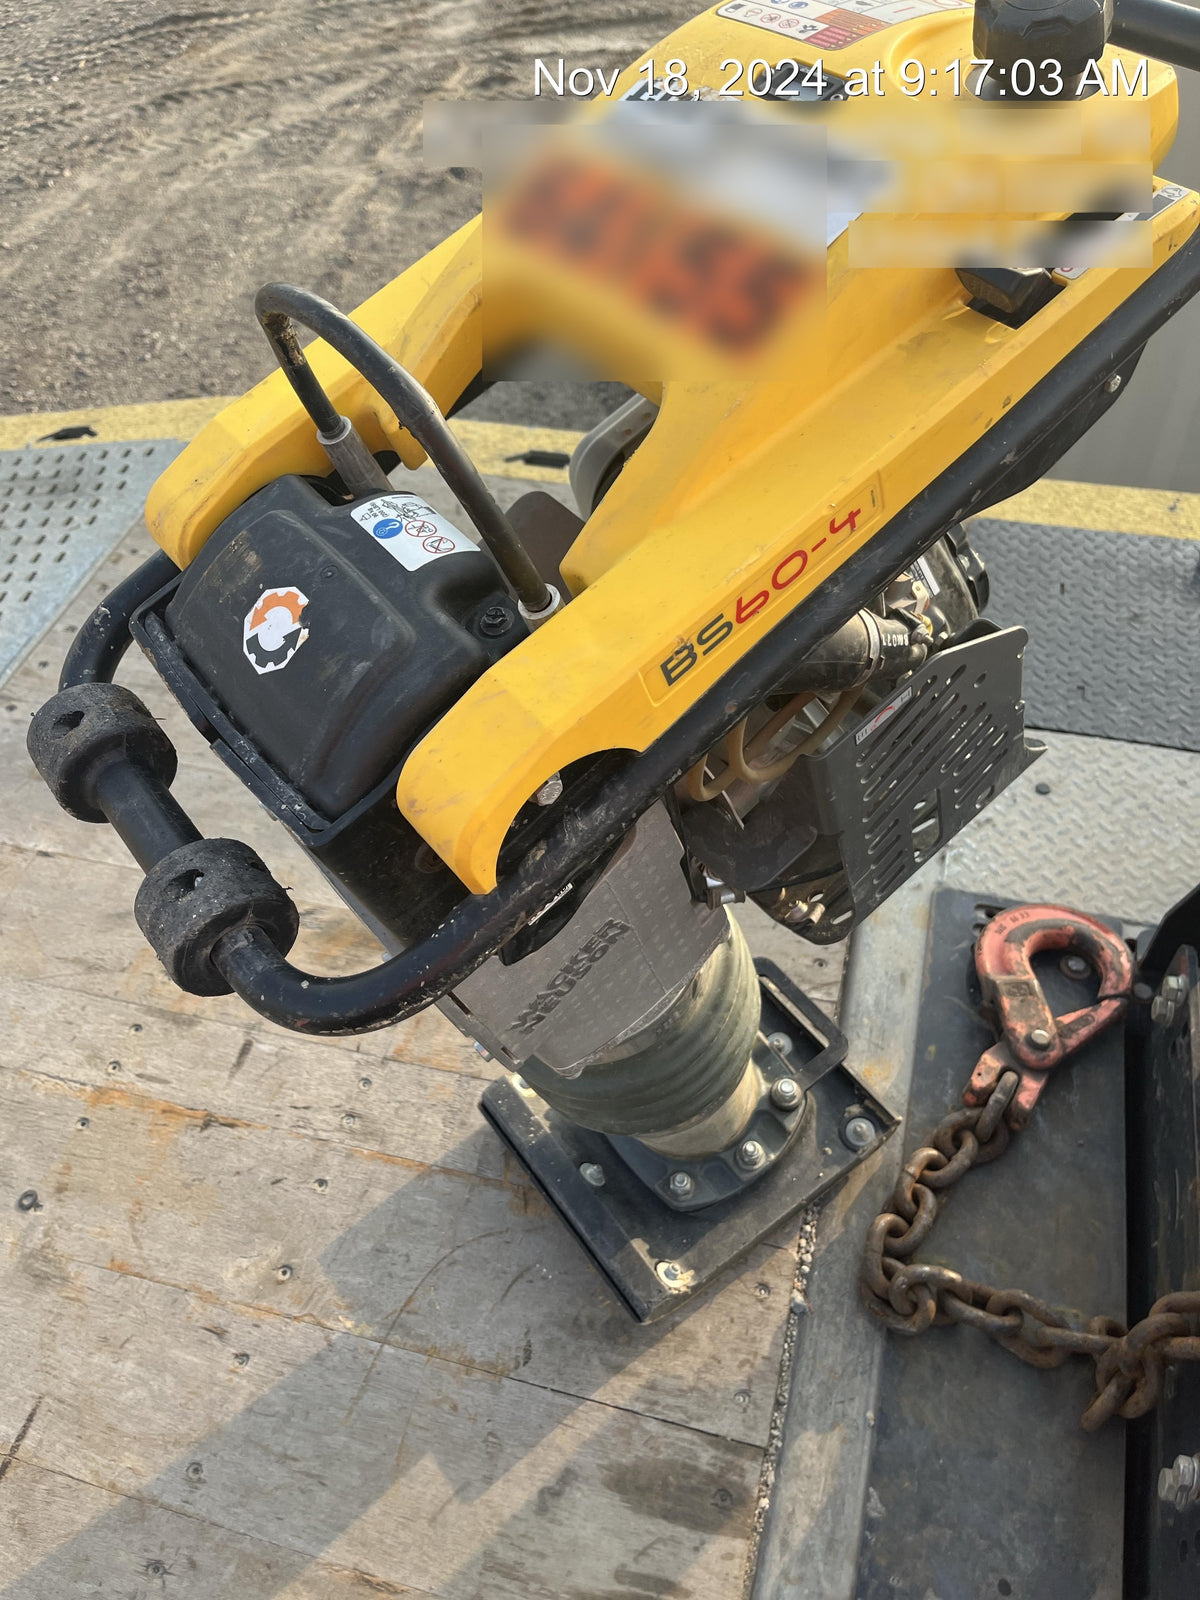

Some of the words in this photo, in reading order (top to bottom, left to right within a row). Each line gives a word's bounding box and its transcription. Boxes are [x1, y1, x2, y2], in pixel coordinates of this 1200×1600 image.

[660, 508, 862, 687] BS60-4
[504, 917, 624, 1031] WACKER
[519, 920, 634, 1035] NEUSON
